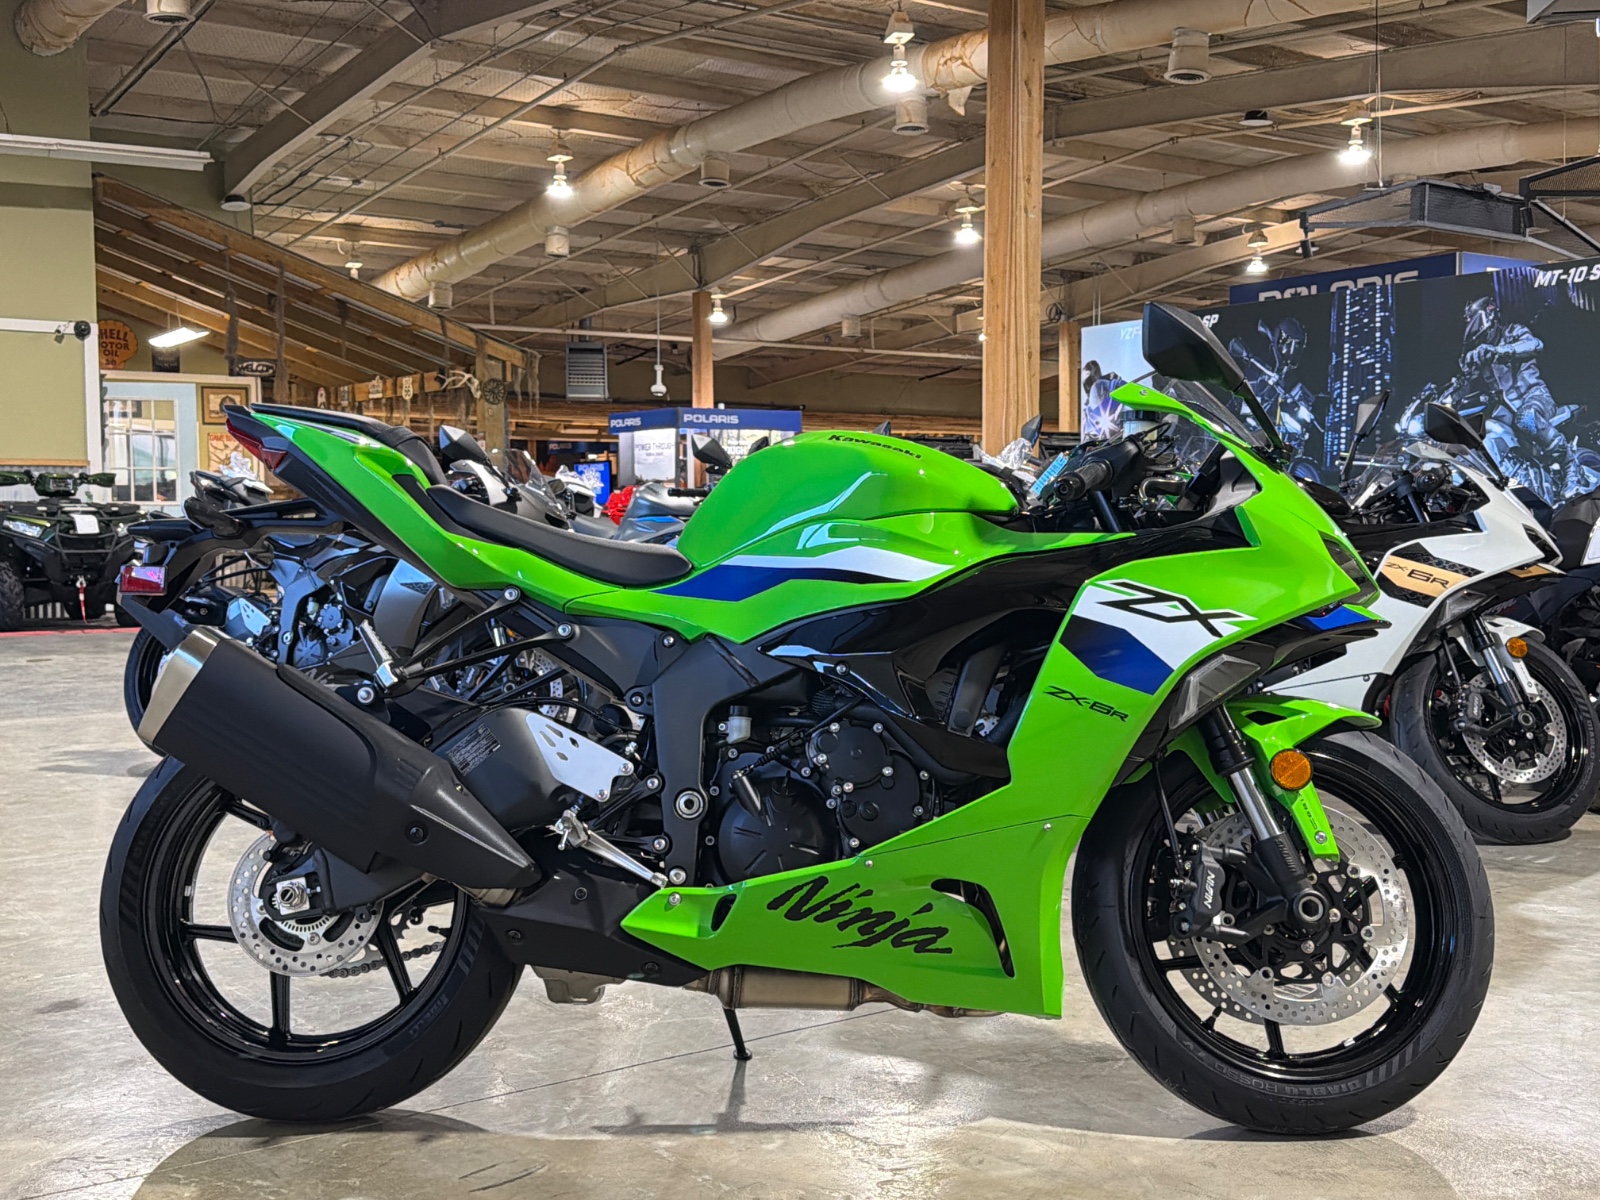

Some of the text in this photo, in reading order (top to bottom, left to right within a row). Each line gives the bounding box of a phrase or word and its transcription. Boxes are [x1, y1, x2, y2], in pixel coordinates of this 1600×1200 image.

[1534, 266, 1588, 288] MT-10
[1202, 314, 1219, 328] SP
[100, 328, 129, 343] HELL
[101, 341, 130, 351] OTOR
[103, 349, 119, 357] OIL
[610, 417, 642, 428] POLARIS
[683, 413, 739, 424] POLARIS
[828, 434, 922, 459] Kawasaki
[1383, 561, 1450, 590] ZX-6R
[1094, 580, 1244, 638] ZX
[1042, 685, 1129, 723] ZX-6R
[1203, 869, 1216, 910] NISSIN
[767, 875, 953, 955] Ninja
[1214, 1060, 1279, 1094] ROSSO
[1284, 1079, 1362, 1097] DIABLO
